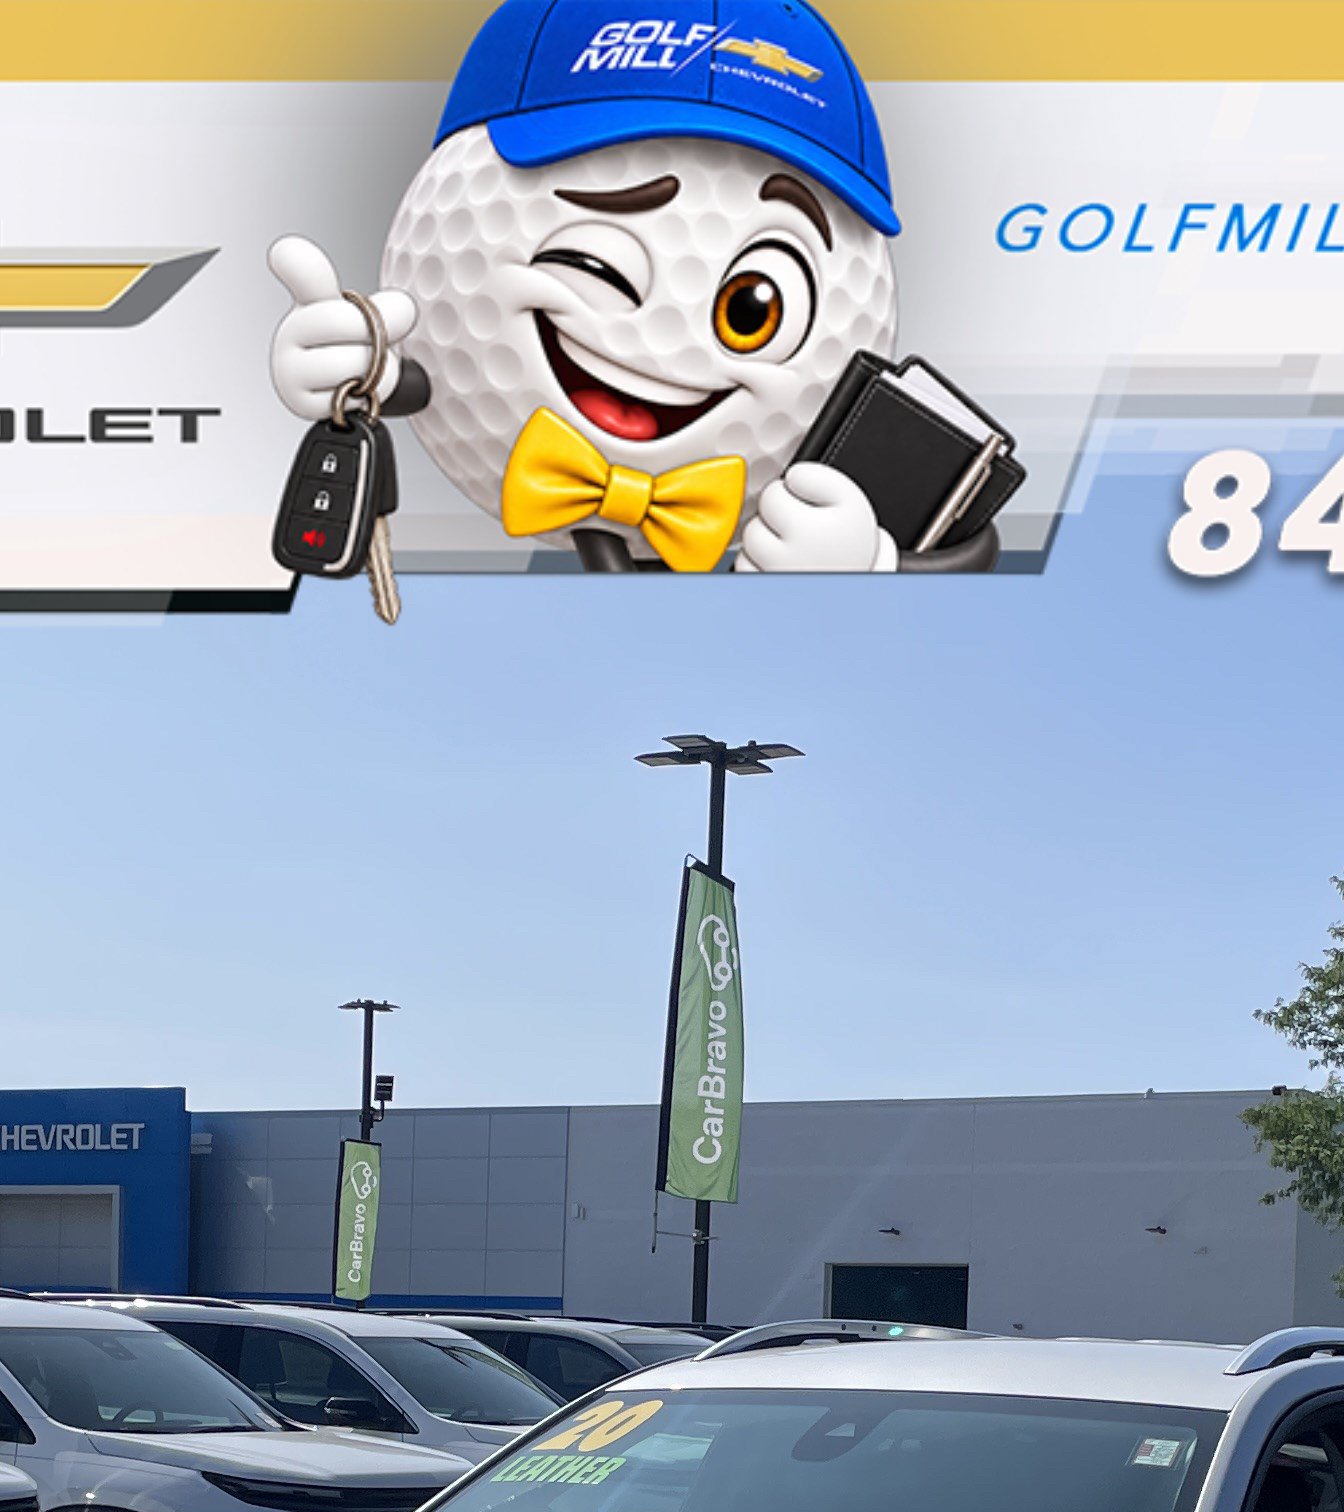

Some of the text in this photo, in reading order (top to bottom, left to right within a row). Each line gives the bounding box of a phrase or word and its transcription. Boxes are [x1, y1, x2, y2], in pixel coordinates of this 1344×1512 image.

[692, 1001, 727, 1165] CarBravo
[348, 1203, 367, 1283] CarBravo
[532, 1400, 664, 1452] 20
[490, 1455, 627, 1485] LEATHER
